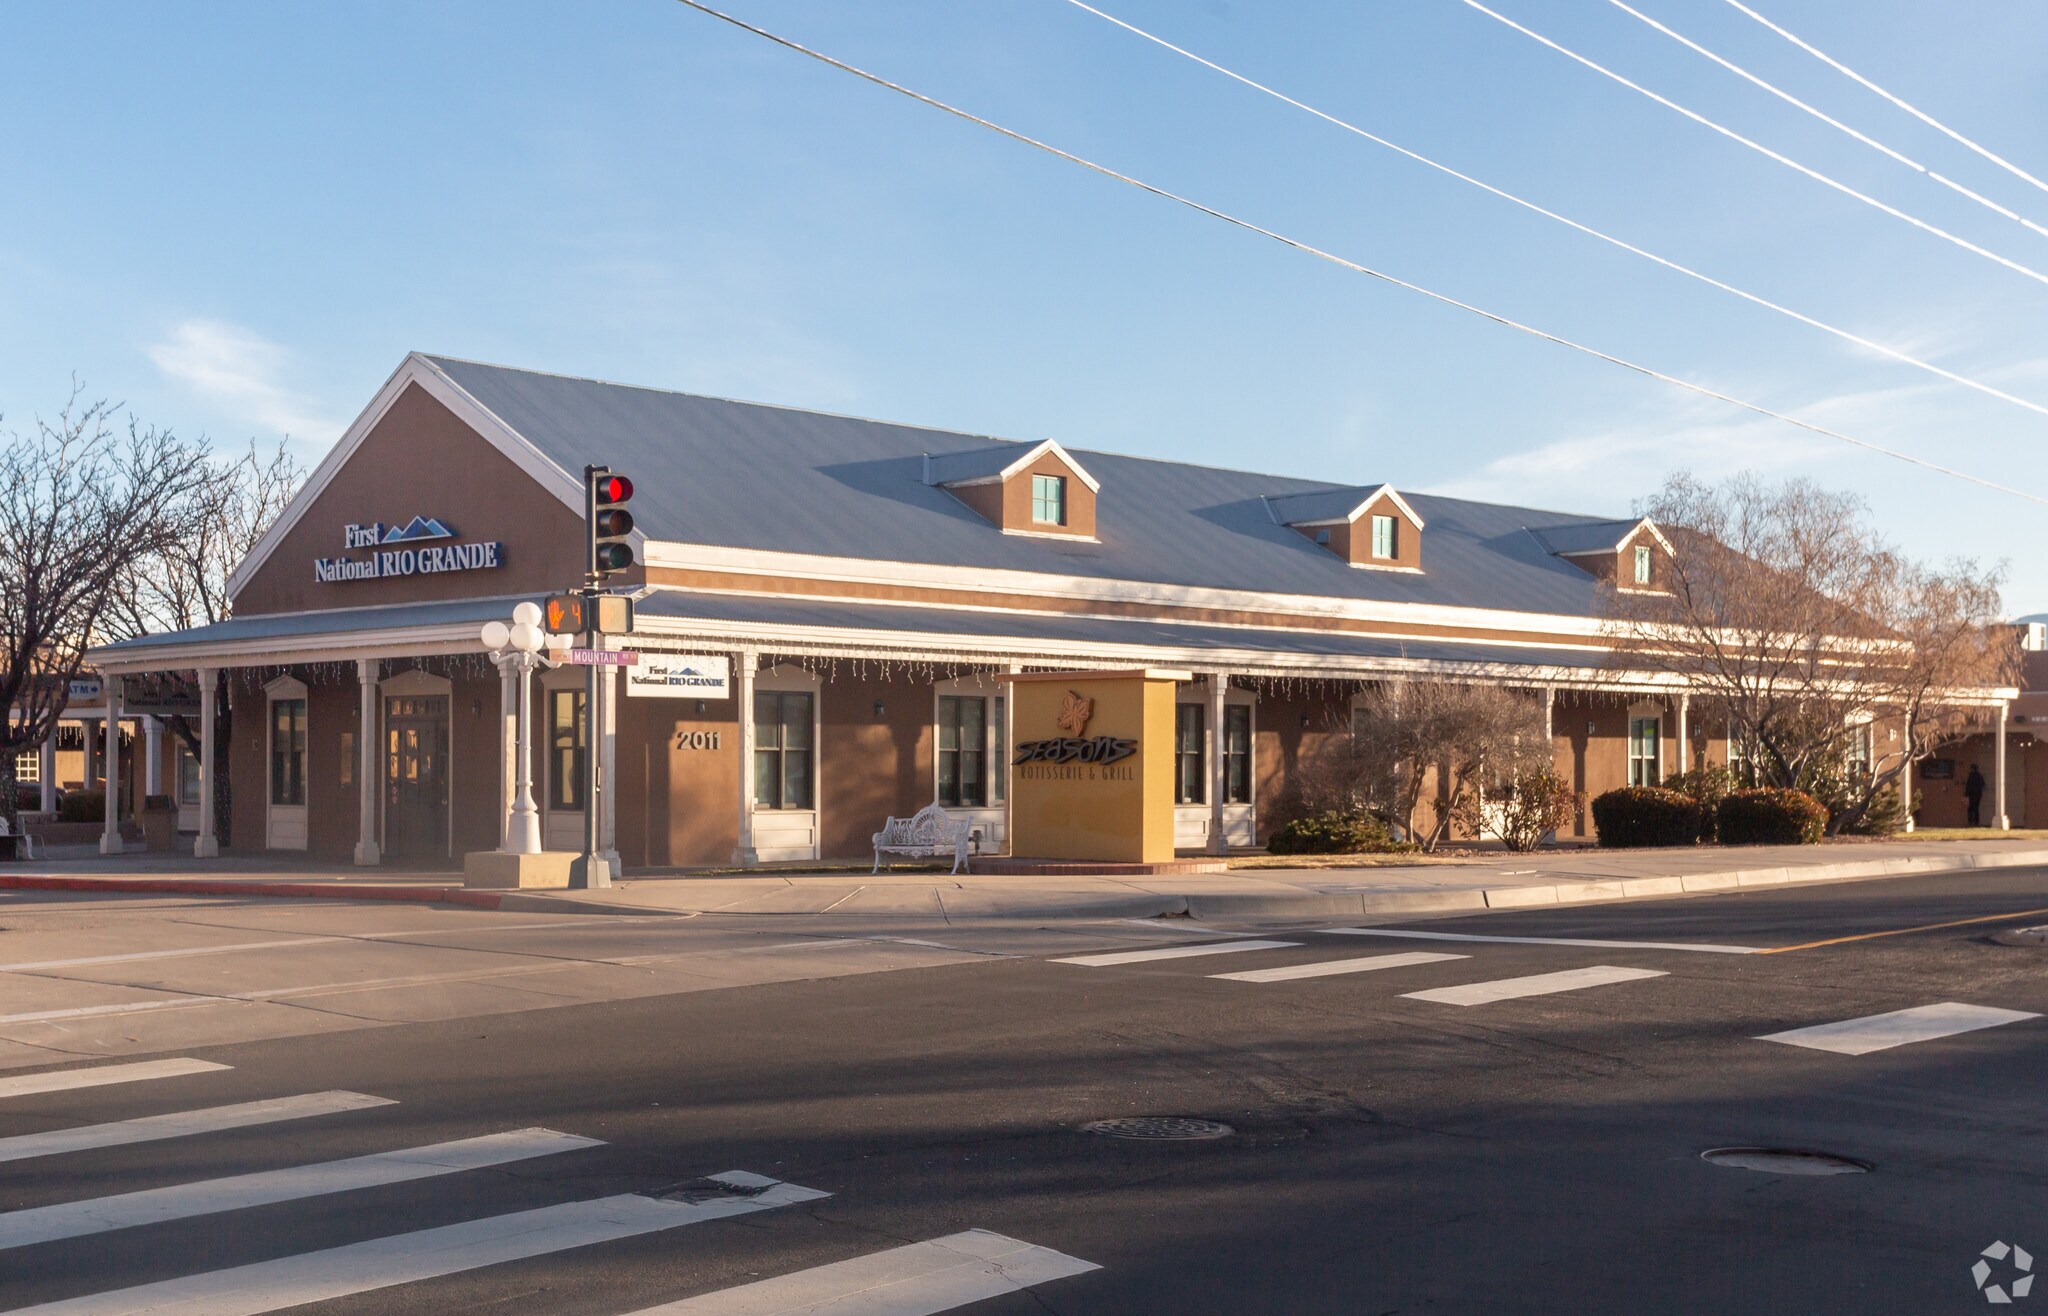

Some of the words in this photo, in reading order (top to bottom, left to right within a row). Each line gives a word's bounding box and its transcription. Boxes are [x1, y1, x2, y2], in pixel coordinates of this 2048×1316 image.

[344, 523, 380, 549] First
[314, 552, 380, 583] National
[382, 550, 415, 576] RIO
[418, 542, 498, 573] GRANDE
[571, 603, 581, 625] 4
[574, 651, 618, 663] MOUNTAIN
[649, 666, 668, 675] First
[631, 676, 668, 686] National
[668, 677, 686, 686] RIO
[687, 678, 725, 687] GRANDE
[678, 731, 721, 750] 2011
[1021, 766, 1082, 780] ROTISSERIE
[1090, 767, 1095, 780] &
[1102, 766, 1134, 780] GRILL
